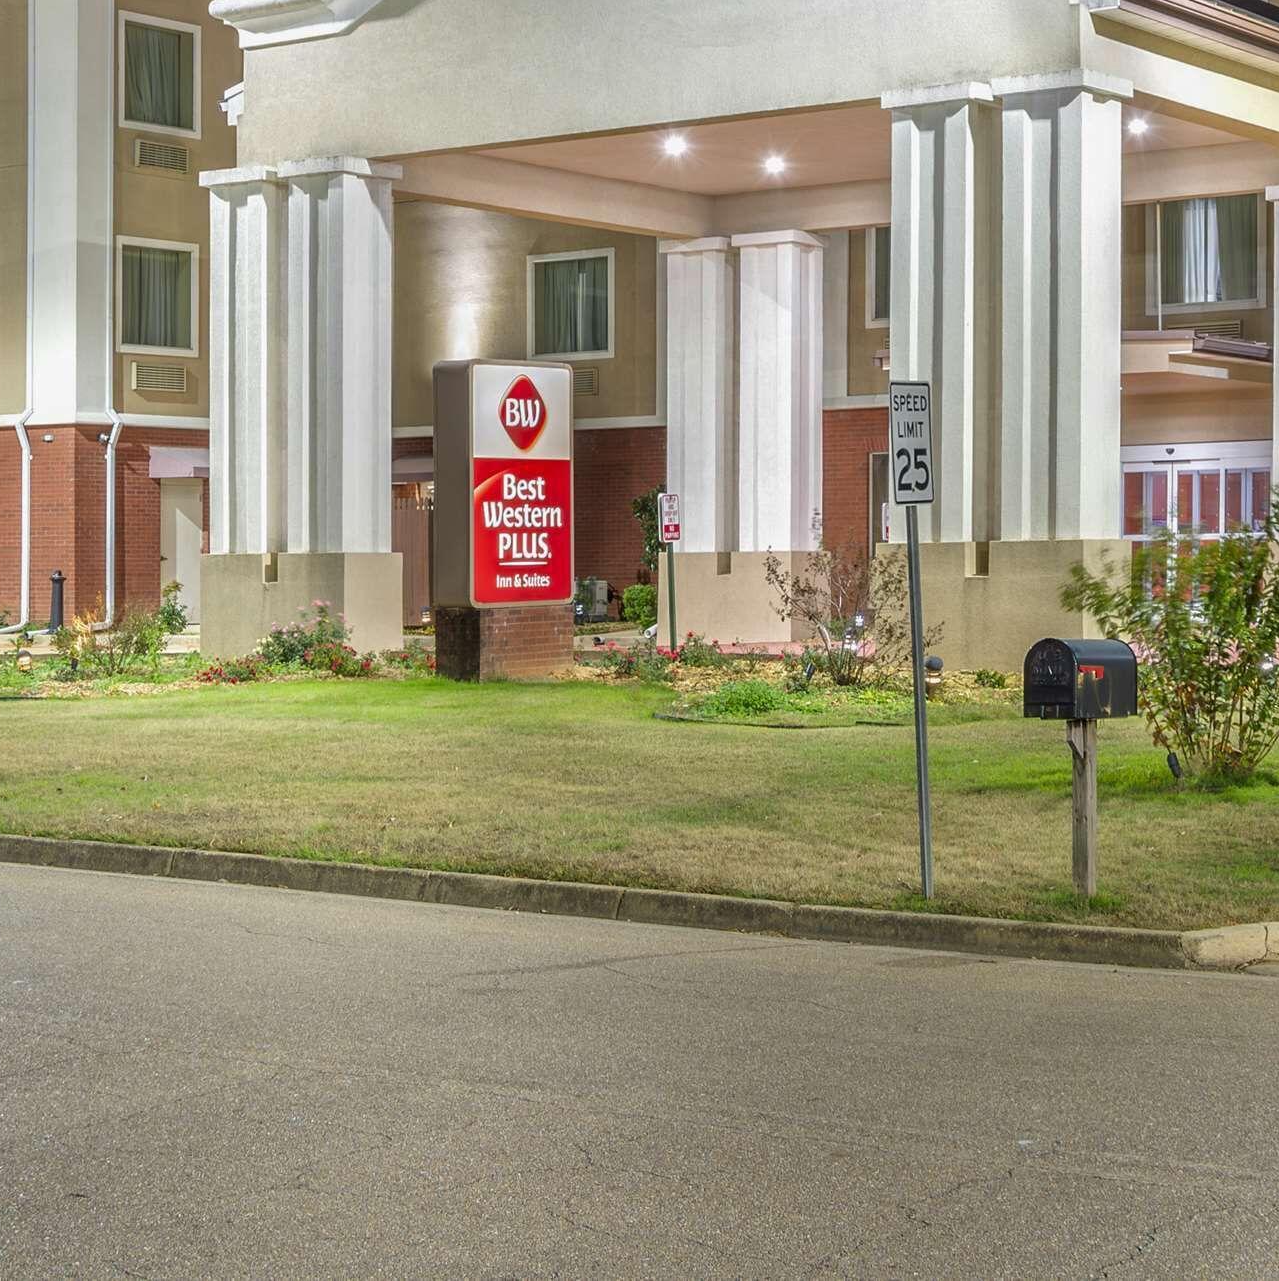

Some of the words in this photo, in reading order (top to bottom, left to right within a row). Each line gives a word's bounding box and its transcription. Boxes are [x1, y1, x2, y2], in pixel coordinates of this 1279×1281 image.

[506, 398, 540, 428] BW
[893, 395, 927, 412] SPEED
[897, 421, 923, 438] LIMIT
[896, 448, 929, 491] 25
[503, 473, 546, 500] Best
[483, 501, 562, 528] Western
[496, 574, 512, 588] Inn
[514, 574, 521, 587] &
[523, 573, 550, 587] Suites
